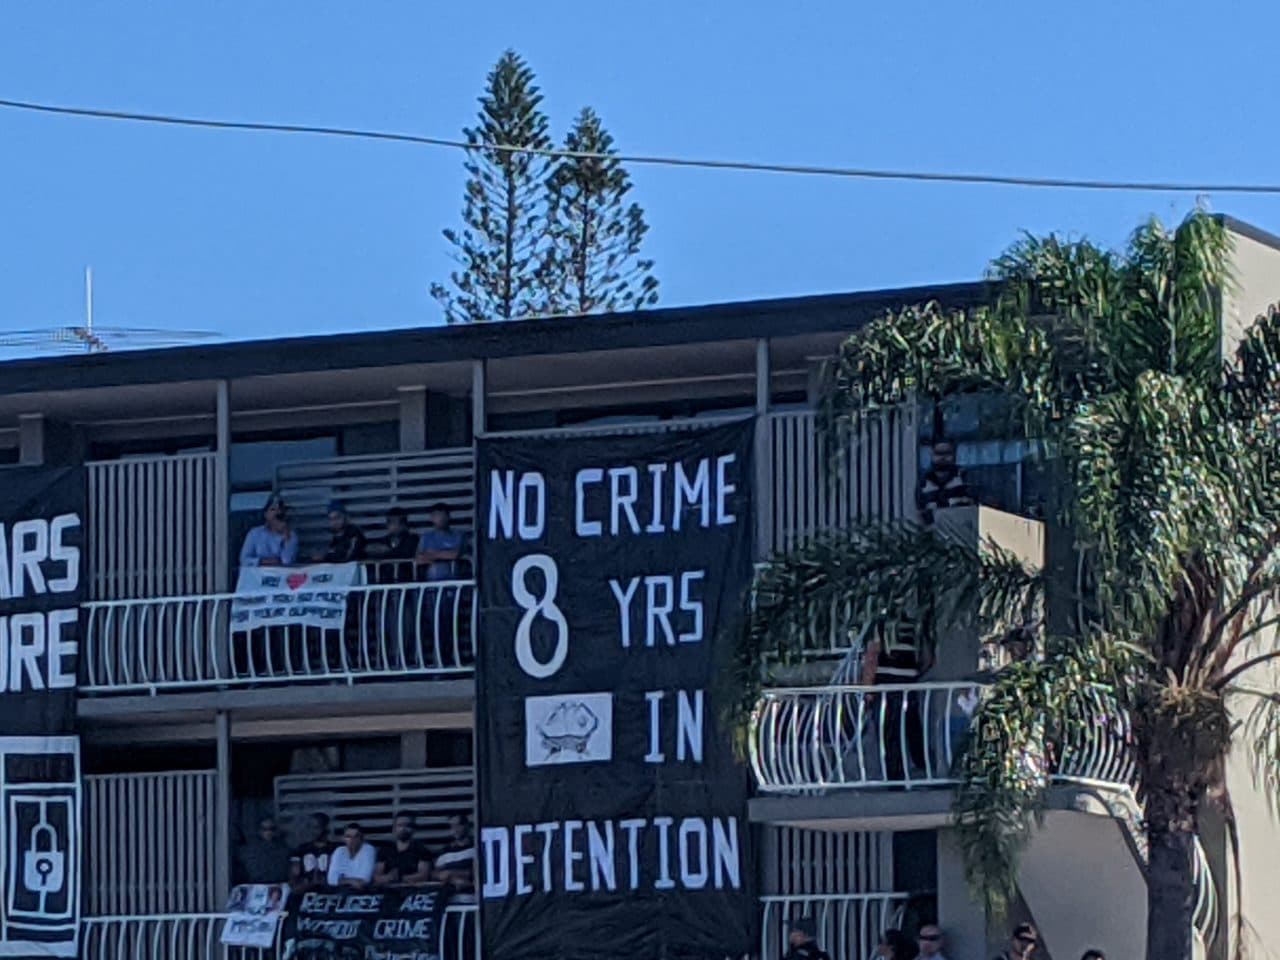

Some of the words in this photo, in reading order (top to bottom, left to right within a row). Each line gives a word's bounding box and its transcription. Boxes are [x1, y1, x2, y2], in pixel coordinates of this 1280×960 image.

[488, 469, 546, 541] NO
[575, 454, 737, 537] CRIME
[512, 554, 569, 678] 8
[609, 570, 705, 647] YRS
[644, 690, 703, 763] IN
[481, 817, 741, 898] DETENTION
[373, 917, 433, 940] CRIME
[400, 892, 438, 913] ARE
